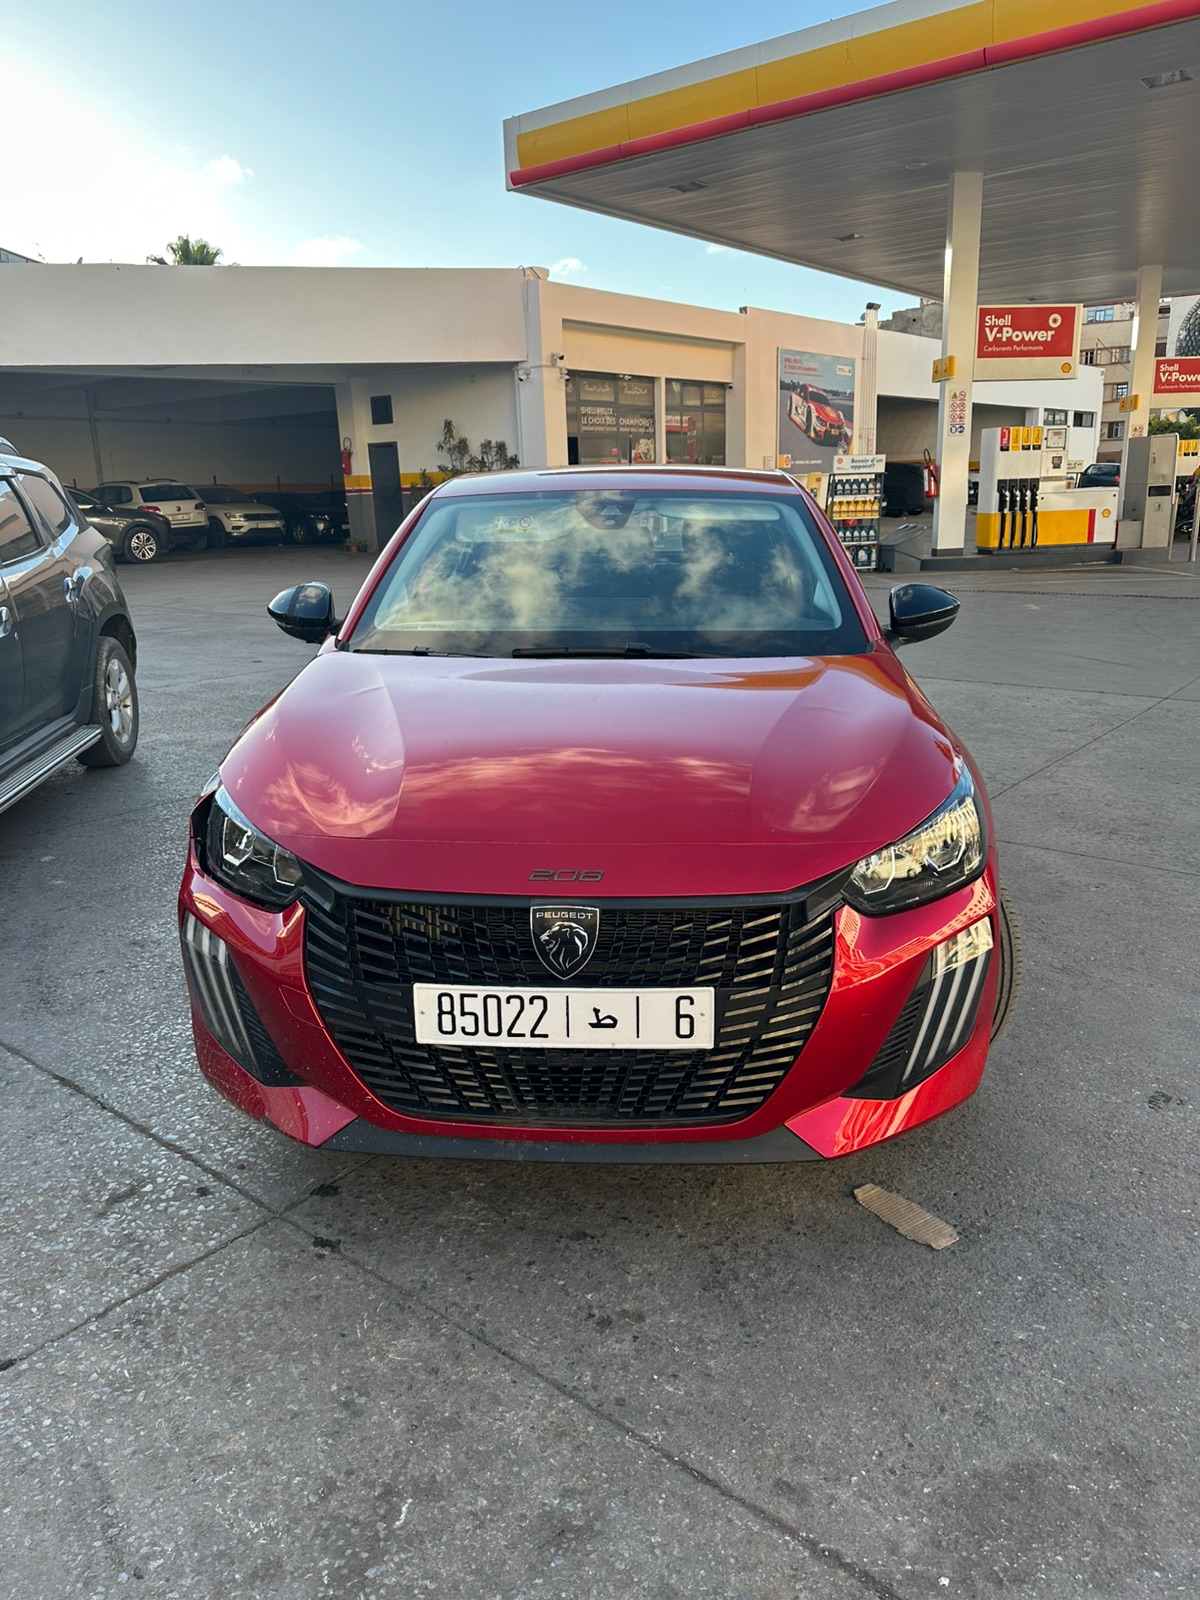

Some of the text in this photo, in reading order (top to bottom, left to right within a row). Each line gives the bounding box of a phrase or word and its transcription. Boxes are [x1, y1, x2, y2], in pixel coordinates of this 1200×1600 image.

[984, 315, 1012, 326] Shell
[984, 327, 1055, 342] V-Power
[983, 344, 1044, 353] Carburants Performants
[581, 406, 597, 415] SHELL
[581, 416, 588, 425] LE
[588, 417, 606, 425] CHOIX
[606, 417, 617, 425] DES
[528, 868, 604, 882] 208
[536, 911, 594, 920] PEUGEOT
[437, 992, 696, 1039] 85022 ط 6
